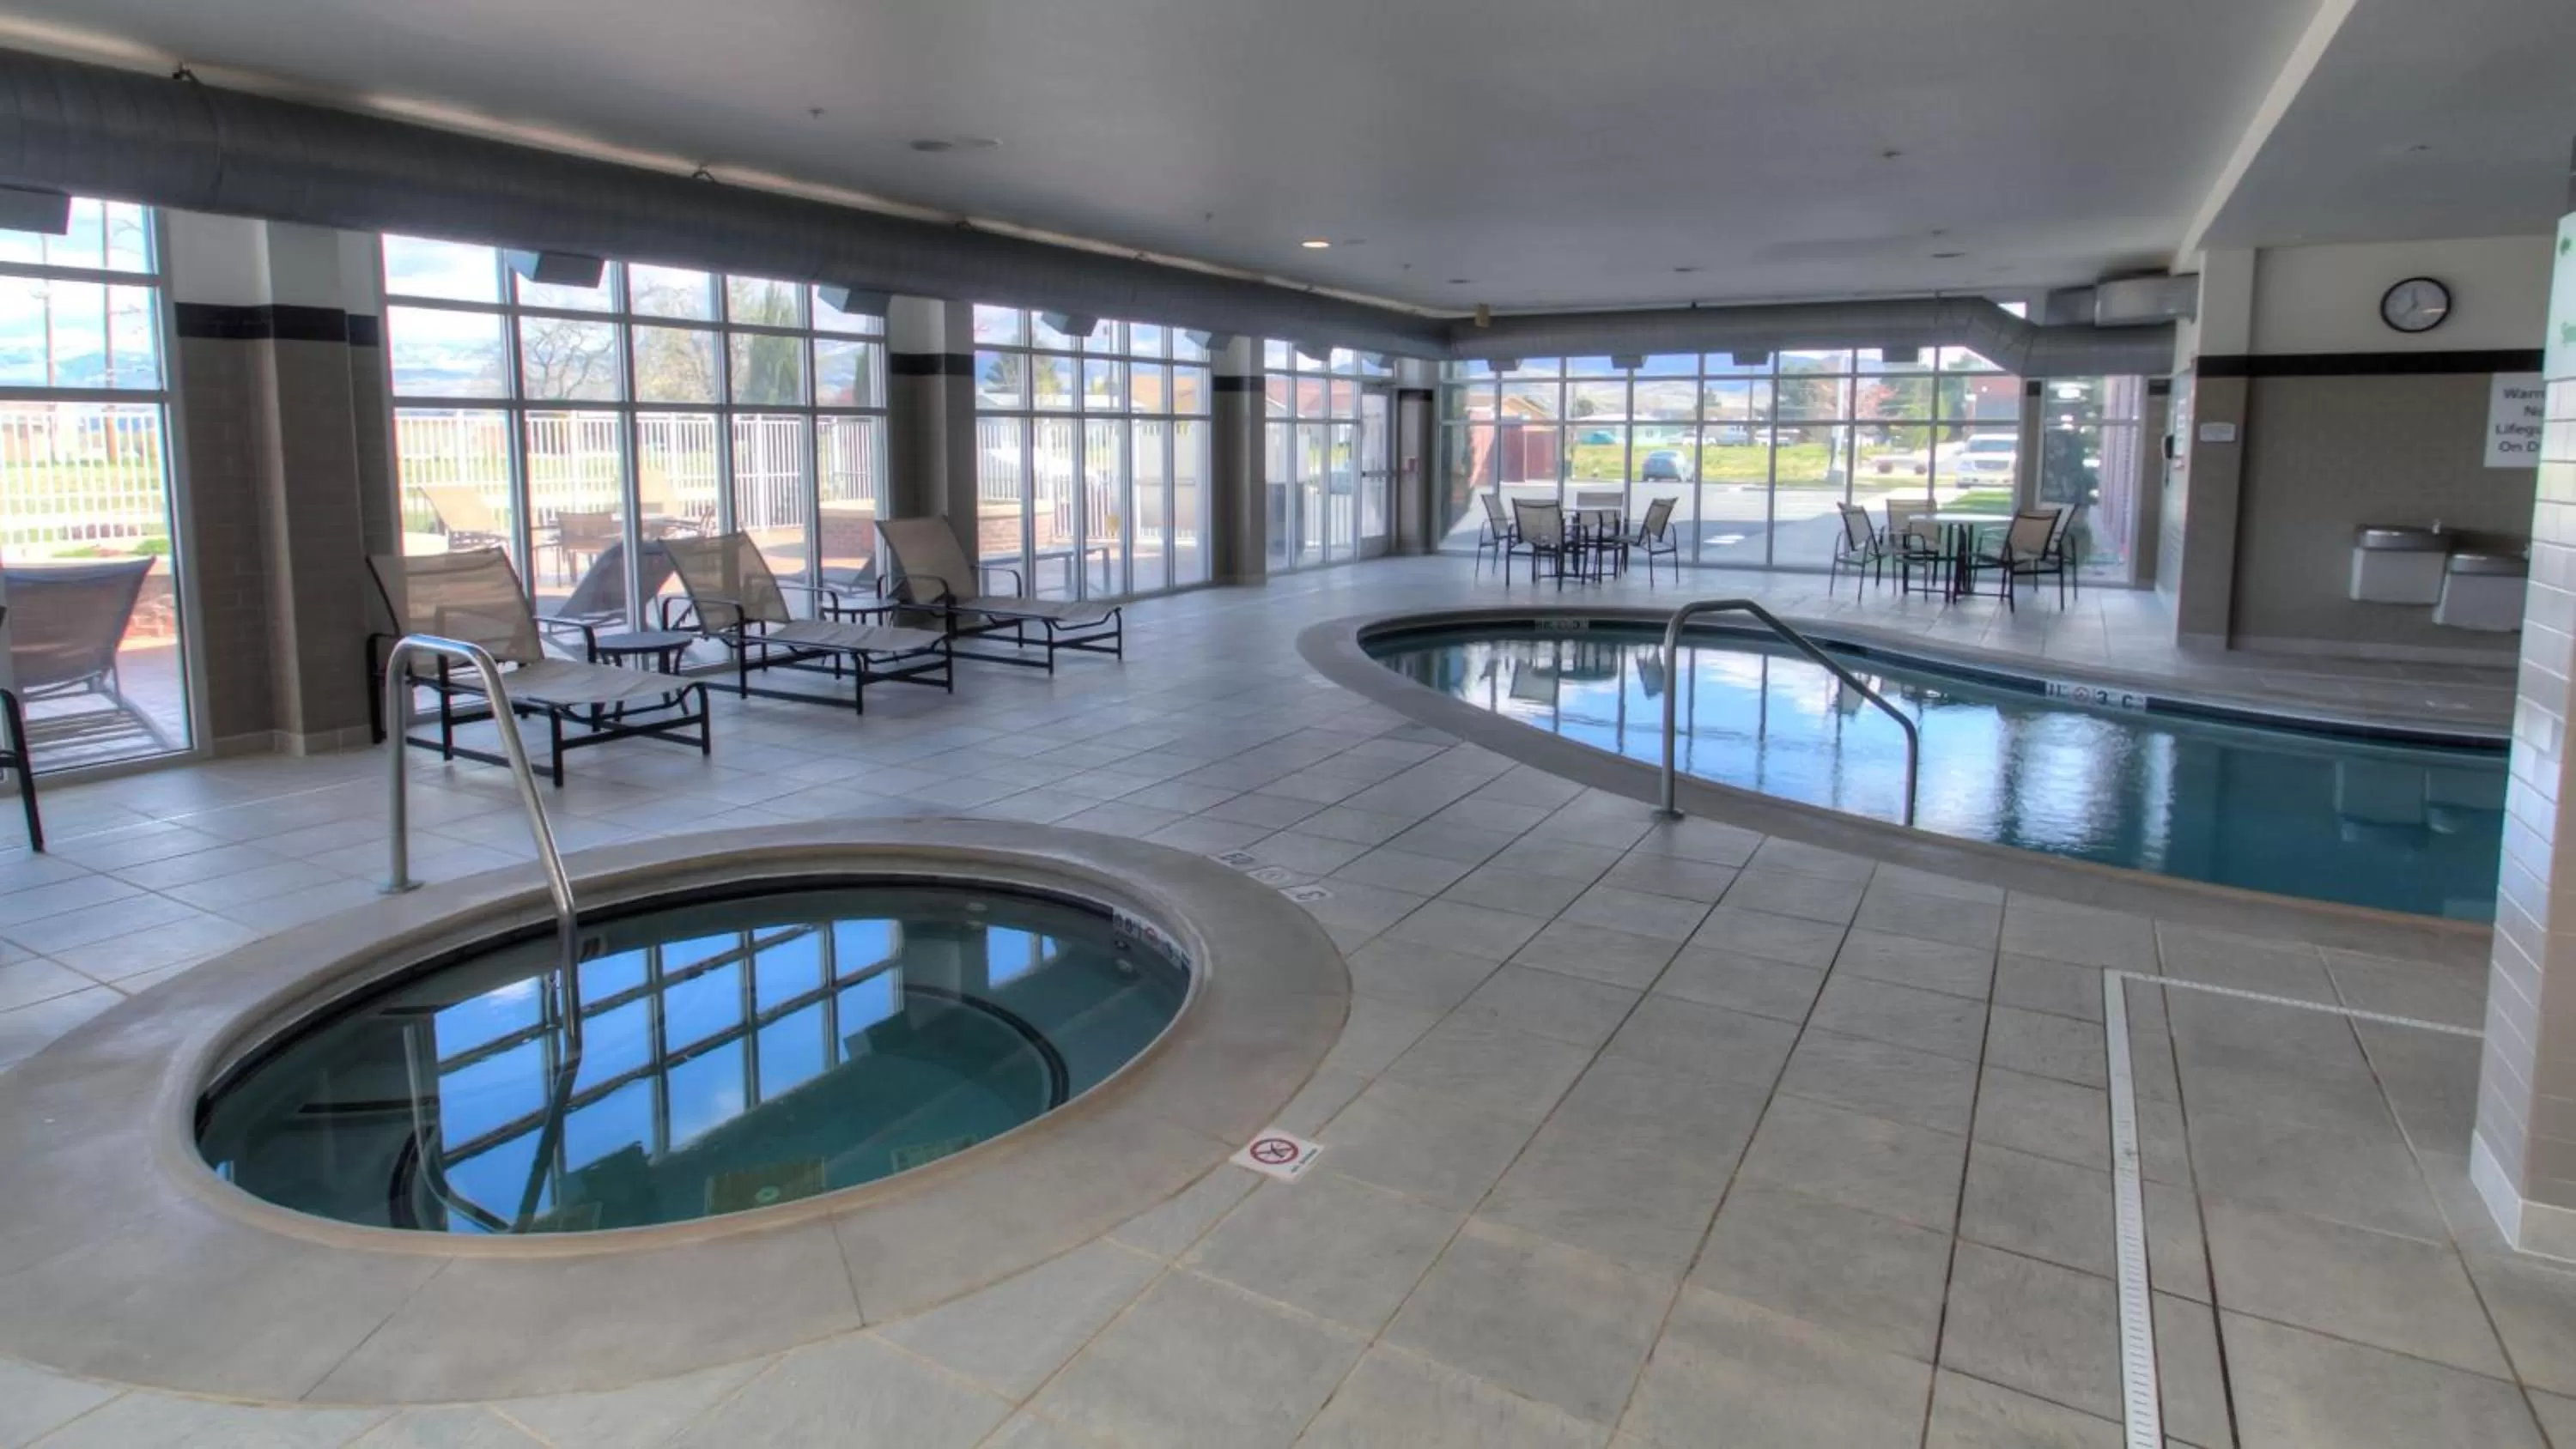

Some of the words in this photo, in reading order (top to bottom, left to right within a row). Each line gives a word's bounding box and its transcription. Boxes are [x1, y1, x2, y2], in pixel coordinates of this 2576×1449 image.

[2503, 388, 2545, 399] Warn
[2494, 422, 2543, 438] Lifegu
[2498, 440, 2523, 452] On
